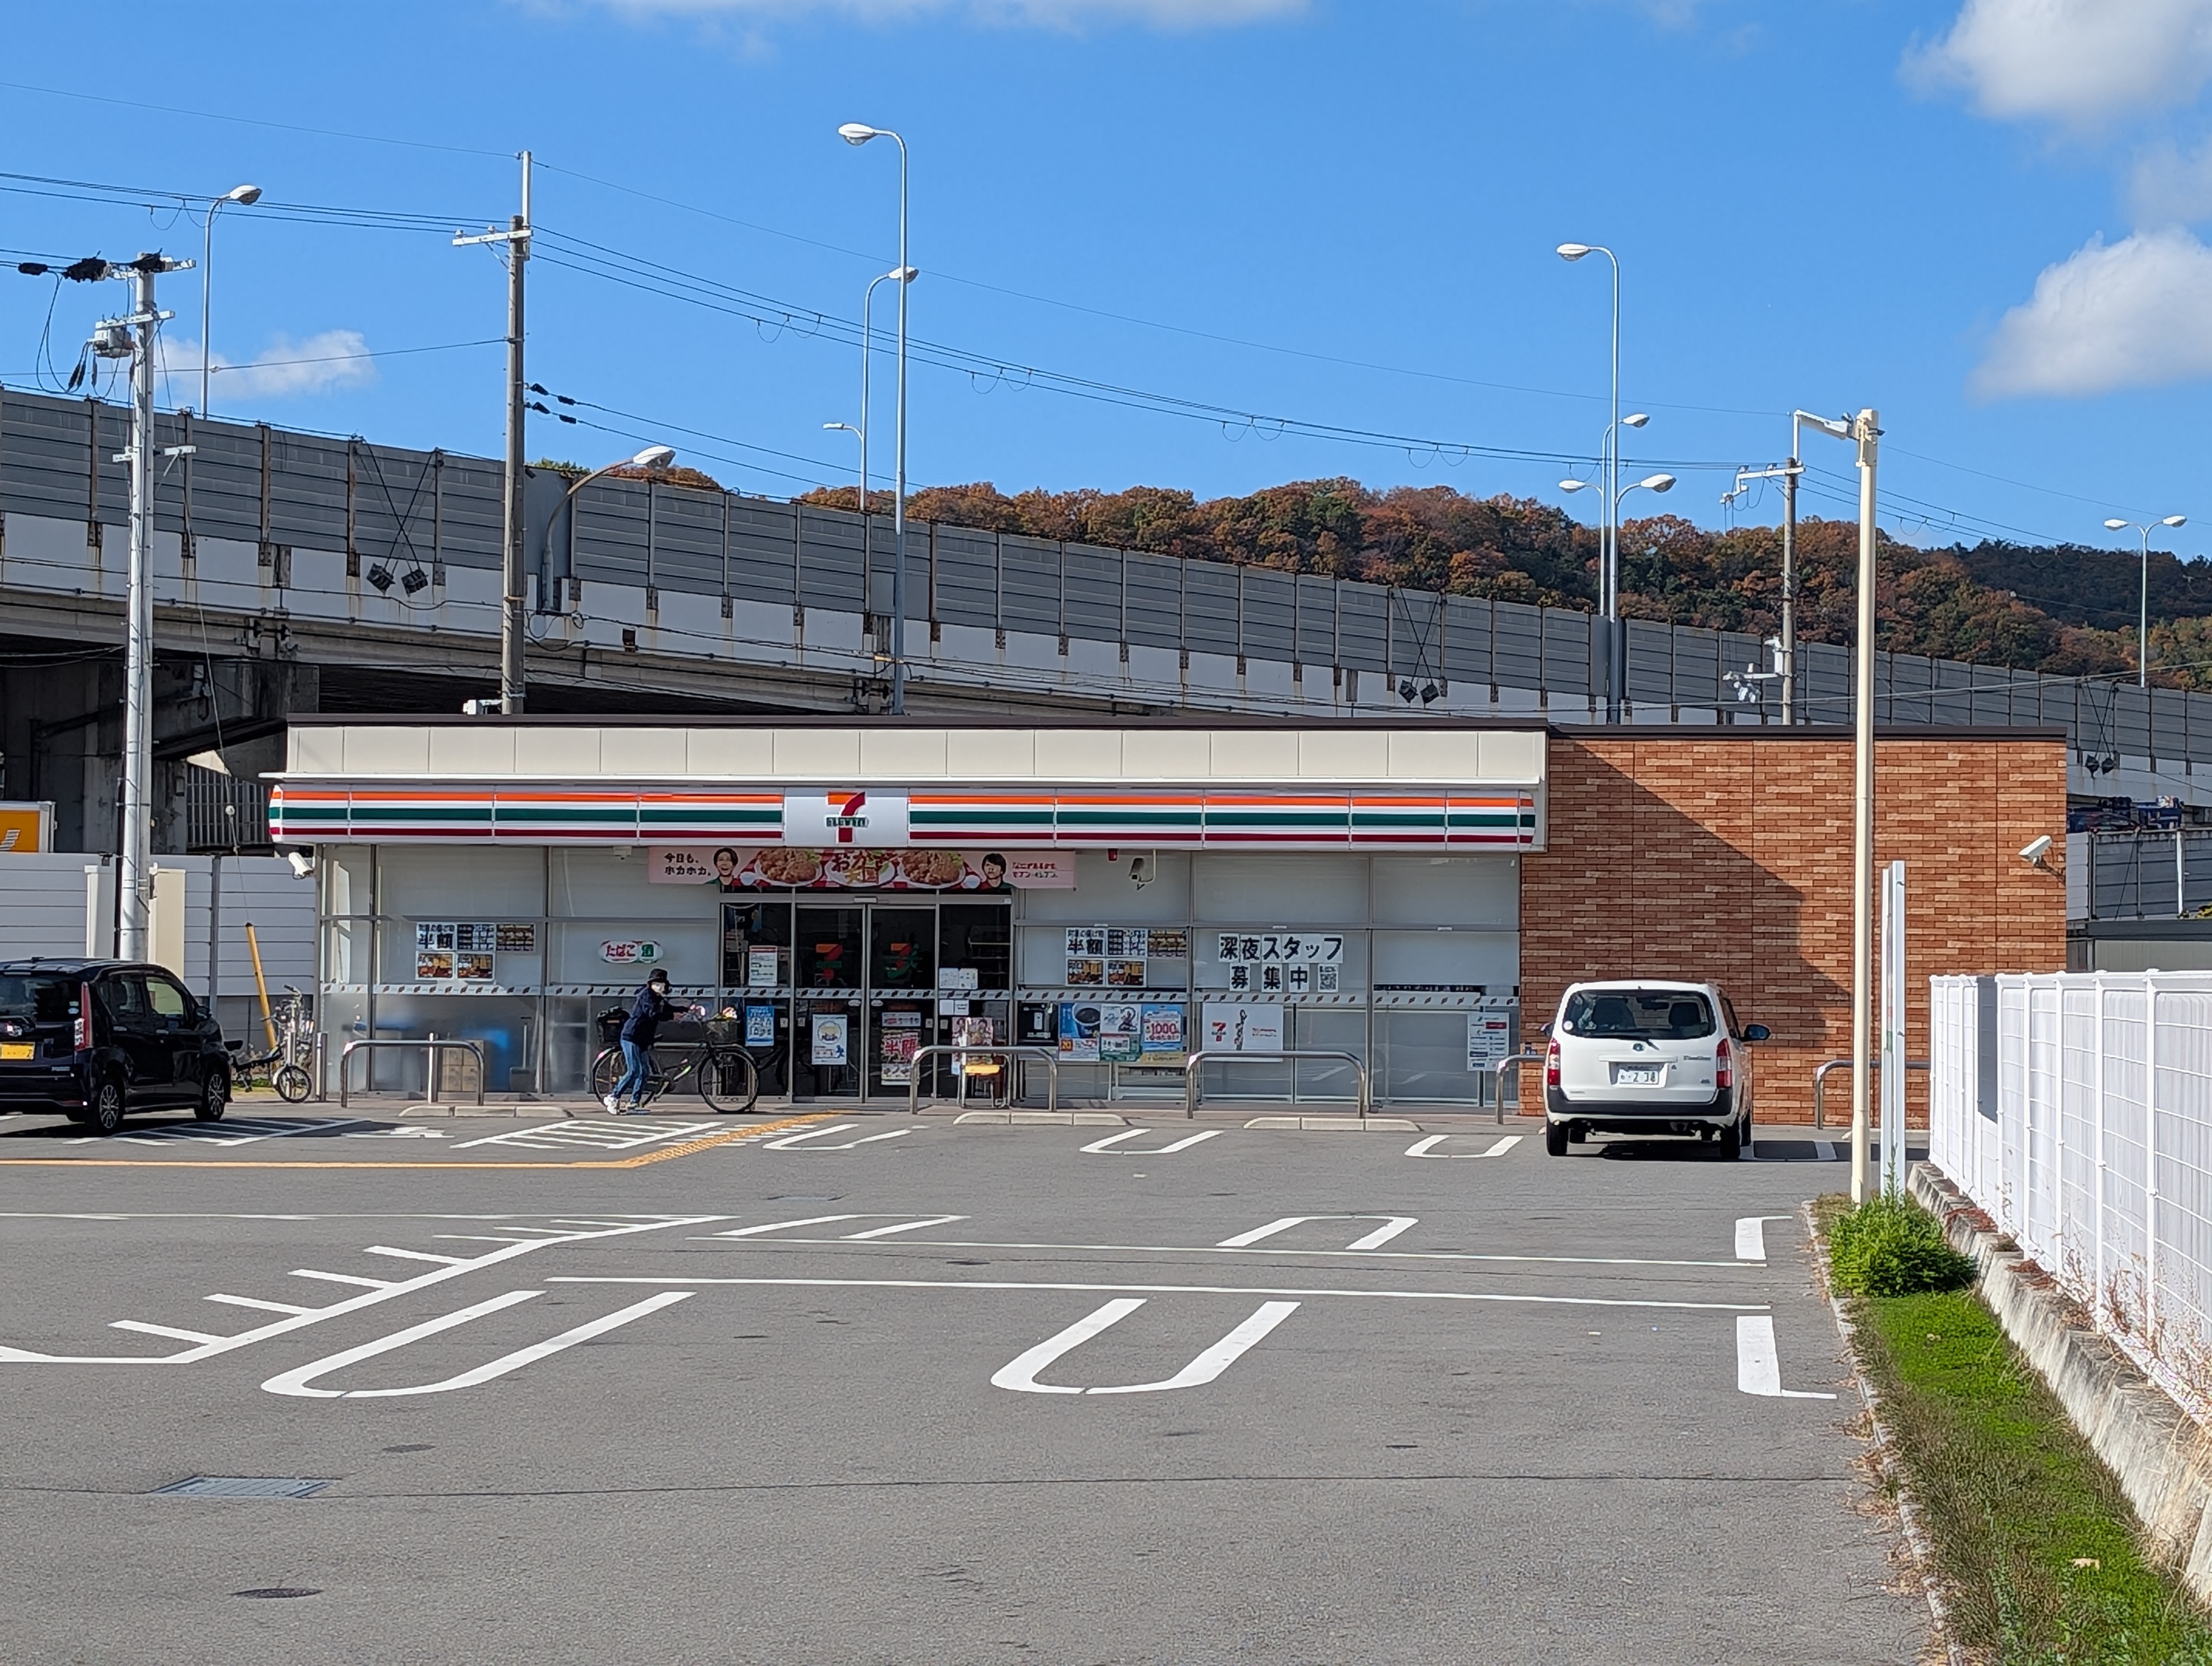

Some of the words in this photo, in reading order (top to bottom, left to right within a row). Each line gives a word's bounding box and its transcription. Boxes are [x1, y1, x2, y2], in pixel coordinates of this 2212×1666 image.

[827, 791, 866, 843] 7
[606, 944, 636, 957] たばこ
[1220, 936, 1342, 960] 深夜スタッフ
[1231, 966, 1308, 990] 募集中
